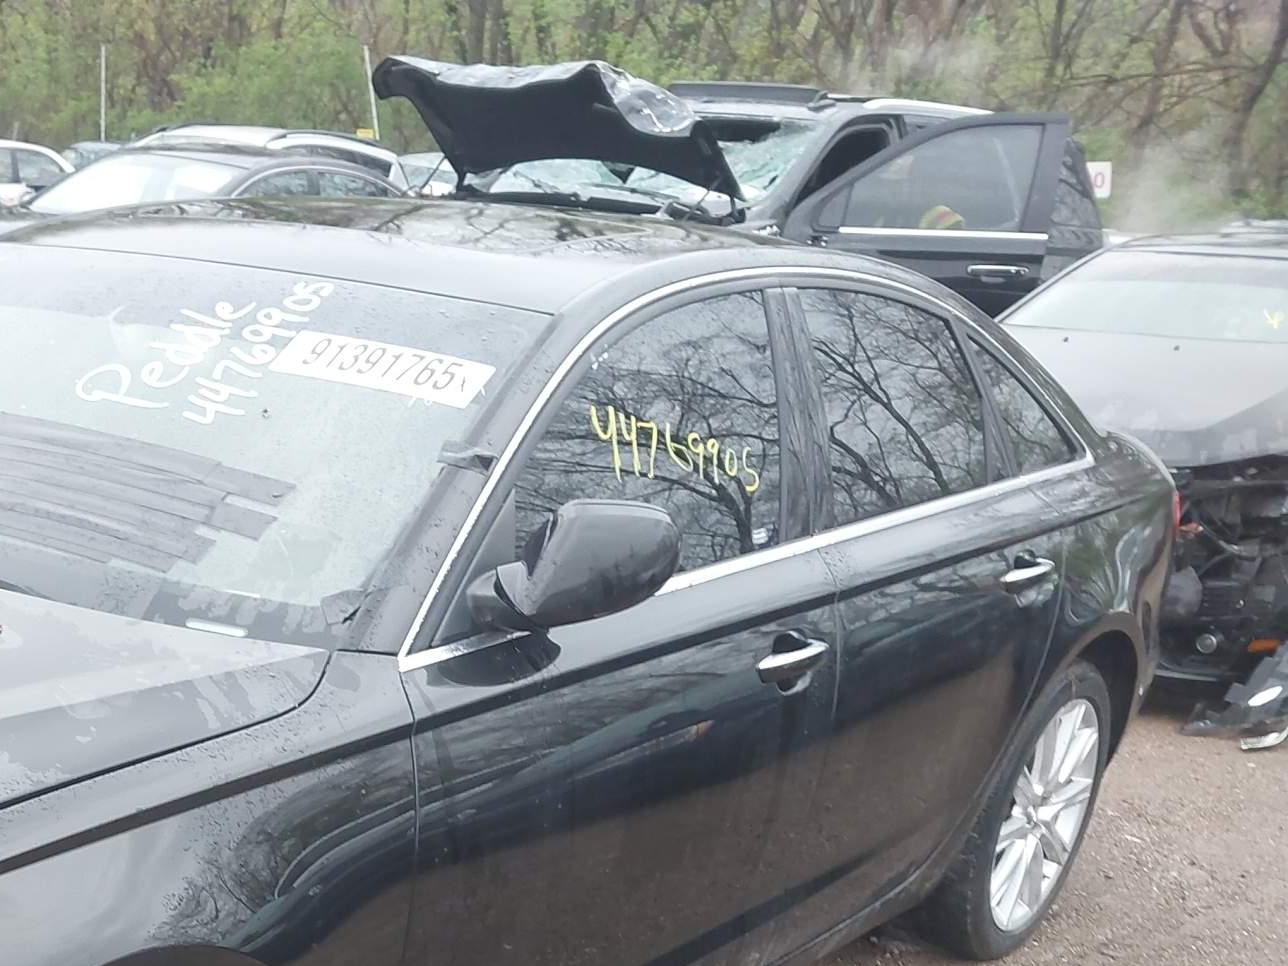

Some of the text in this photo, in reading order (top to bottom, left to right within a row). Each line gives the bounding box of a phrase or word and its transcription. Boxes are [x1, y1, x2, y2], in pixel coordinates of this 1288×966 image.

[182, 281, 335, 424] 44769905
[301, 338, 464, 390] 91391765
[589, 404, 760, 493] 44769905
